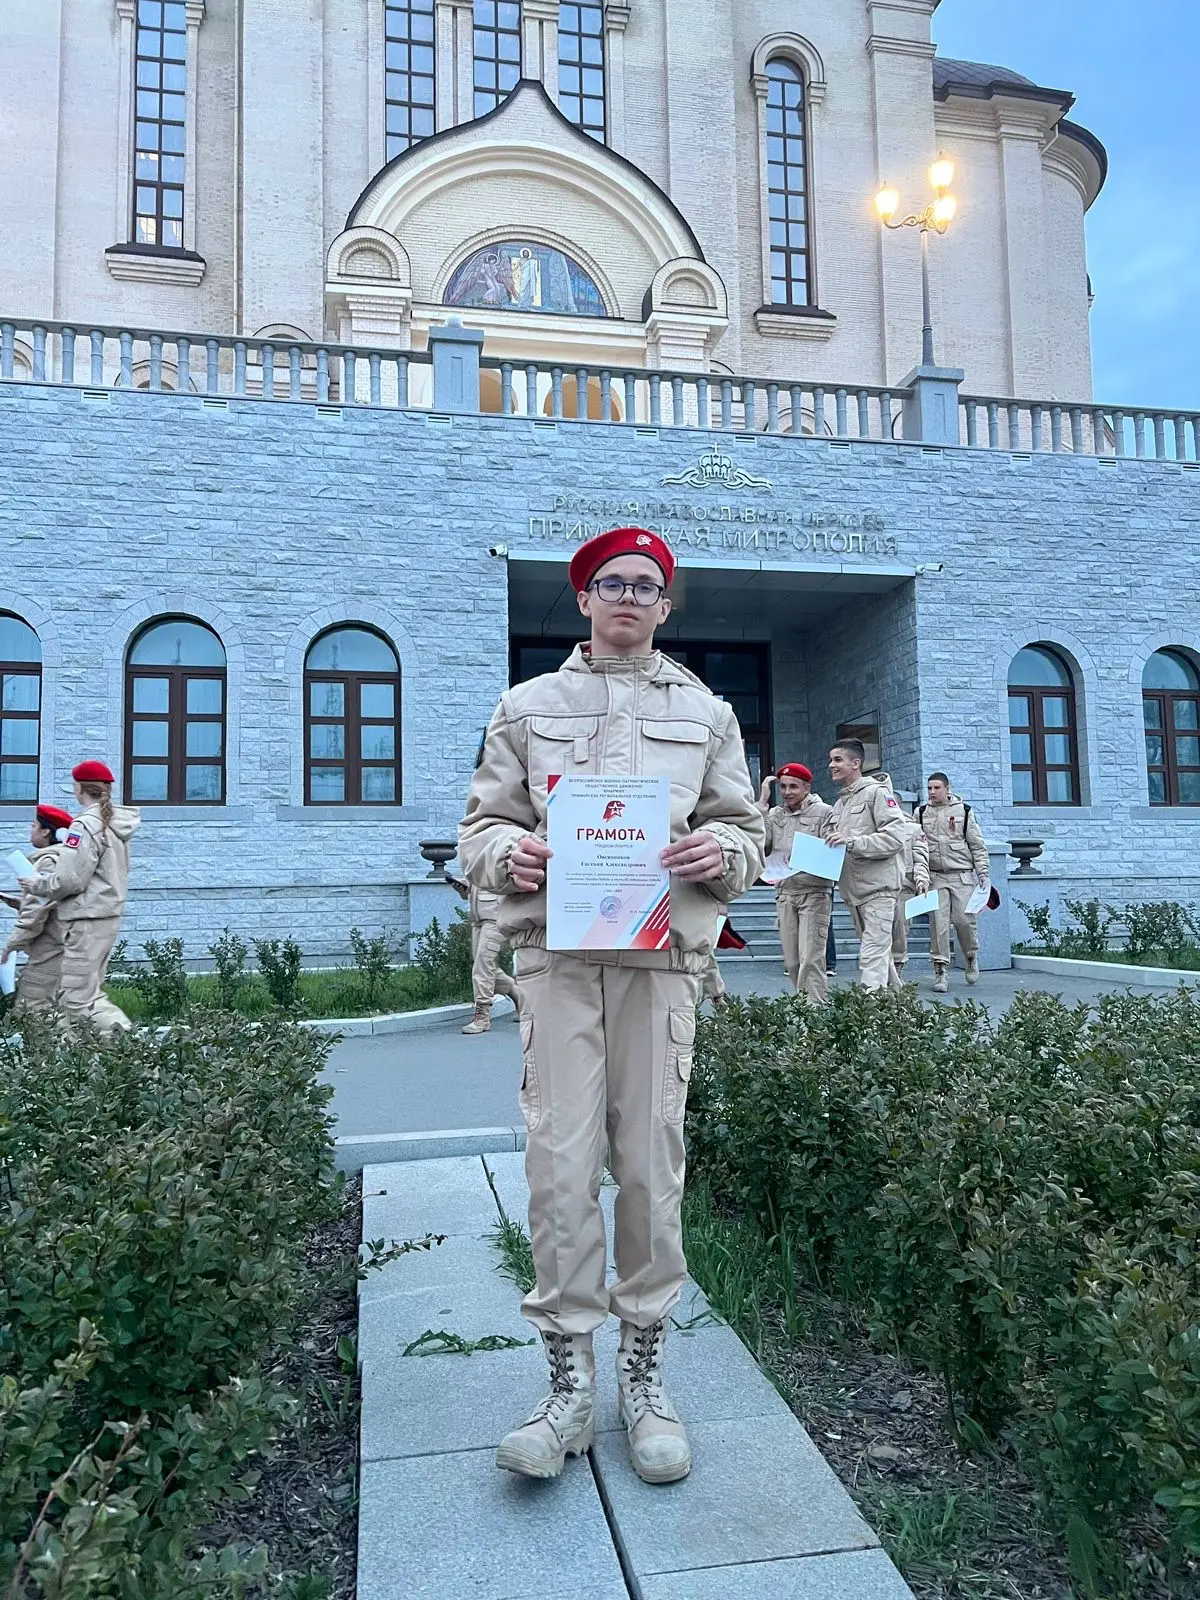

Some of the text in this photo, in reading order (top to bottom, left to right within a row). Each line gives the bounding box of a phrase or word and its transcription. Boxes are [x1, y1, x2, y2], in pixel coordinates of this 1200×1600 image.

[553, 495, 639, 515] РУССКАЯ
[644, 501, 795, 525] ПРАВОСЛАВНАЯ
[529, 517, 898, 555] ПРИМКАЯ МИТРОПОЛИЯ
[577, 828, 646, 841] ГРАМОТА
